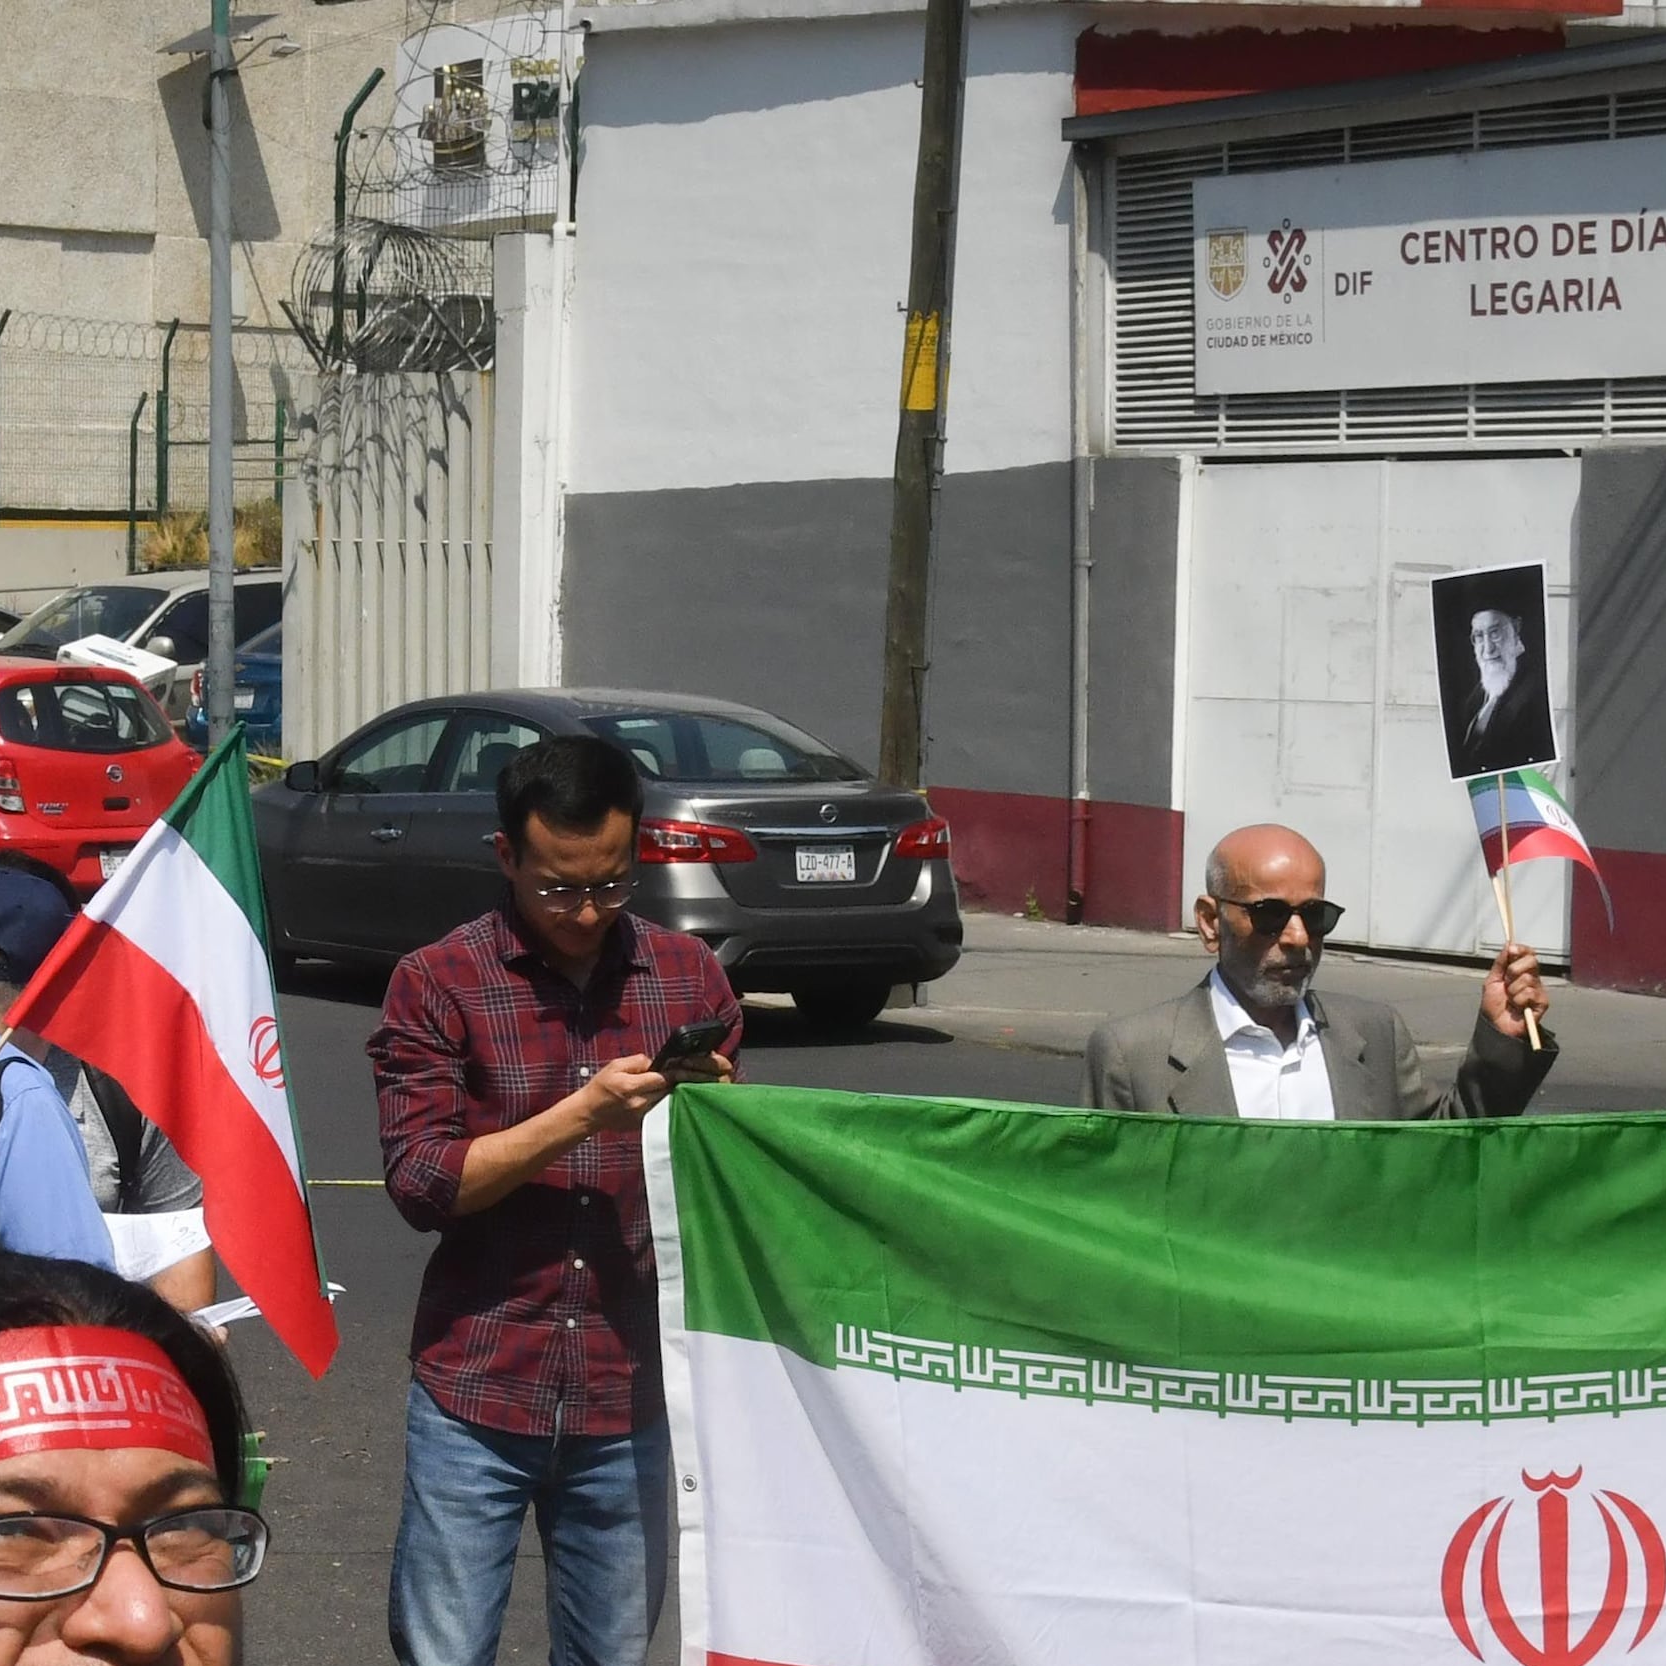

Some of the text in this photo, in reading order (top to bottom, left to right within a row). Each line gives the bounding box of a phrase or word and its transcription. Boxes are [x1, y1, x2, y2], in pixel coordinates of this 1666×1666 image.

[1400, 224, 1539, 265] CENTRO
[1551, 220, 1598, 257] DE
[1335, 271, 1373, 297] DIF
[1470, 276, 1622, 317] LEGARIA
[1206, 312, 1313, 331] GOBIERNO DE LA
[1206, 335, 1249, 349] CIUDAD
[1251, 334, 1267, 347] DE
